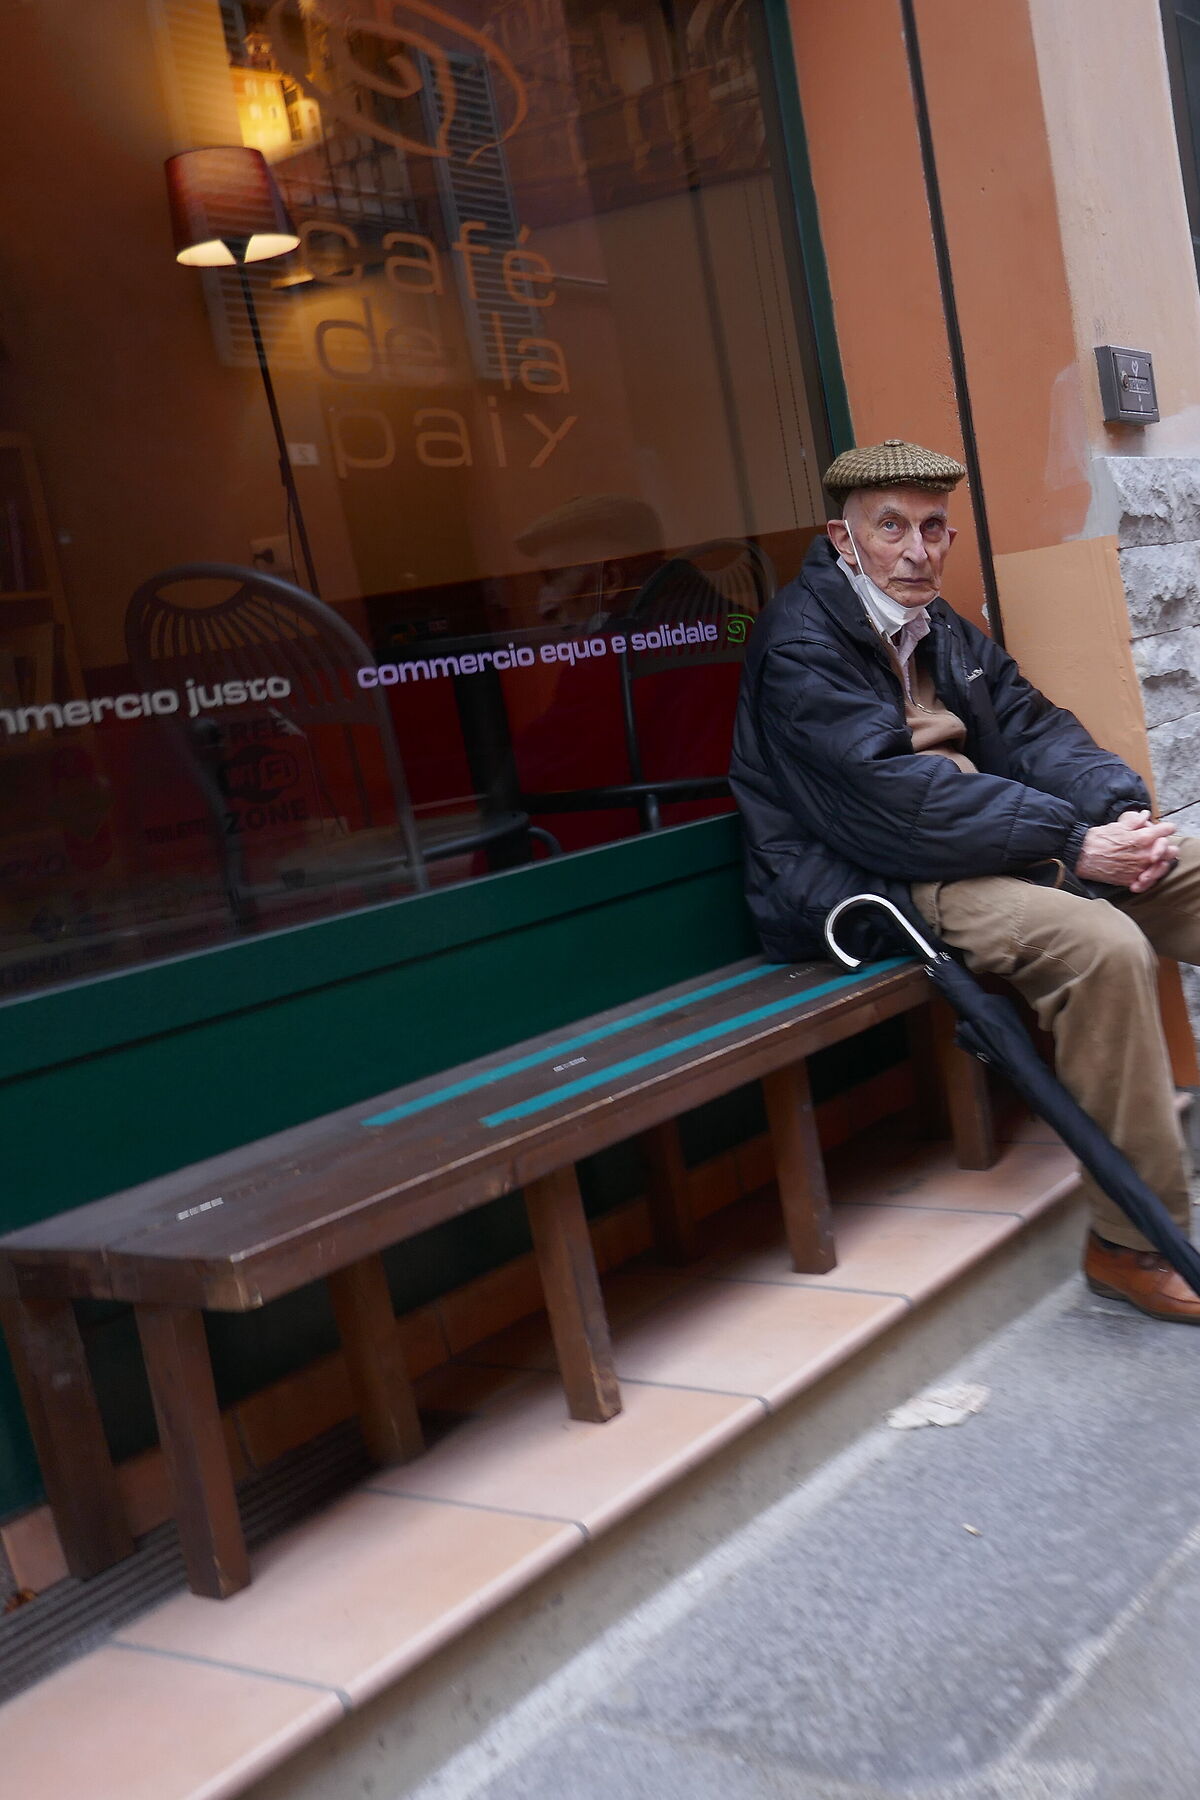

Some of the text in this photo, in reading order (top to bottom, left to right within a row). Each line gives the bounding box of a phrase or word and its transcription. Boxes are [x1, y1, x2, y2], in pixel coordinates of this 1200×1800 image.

[299, 219, 557, 308] café
[313, 296, 571, 395] de la
[329, 395, 579, 480] paix
[356, 621, 719, 690] commercio equo e solidale
[184, 675, 292, 719] justo
[225, 797, 310, 834] ZONE
